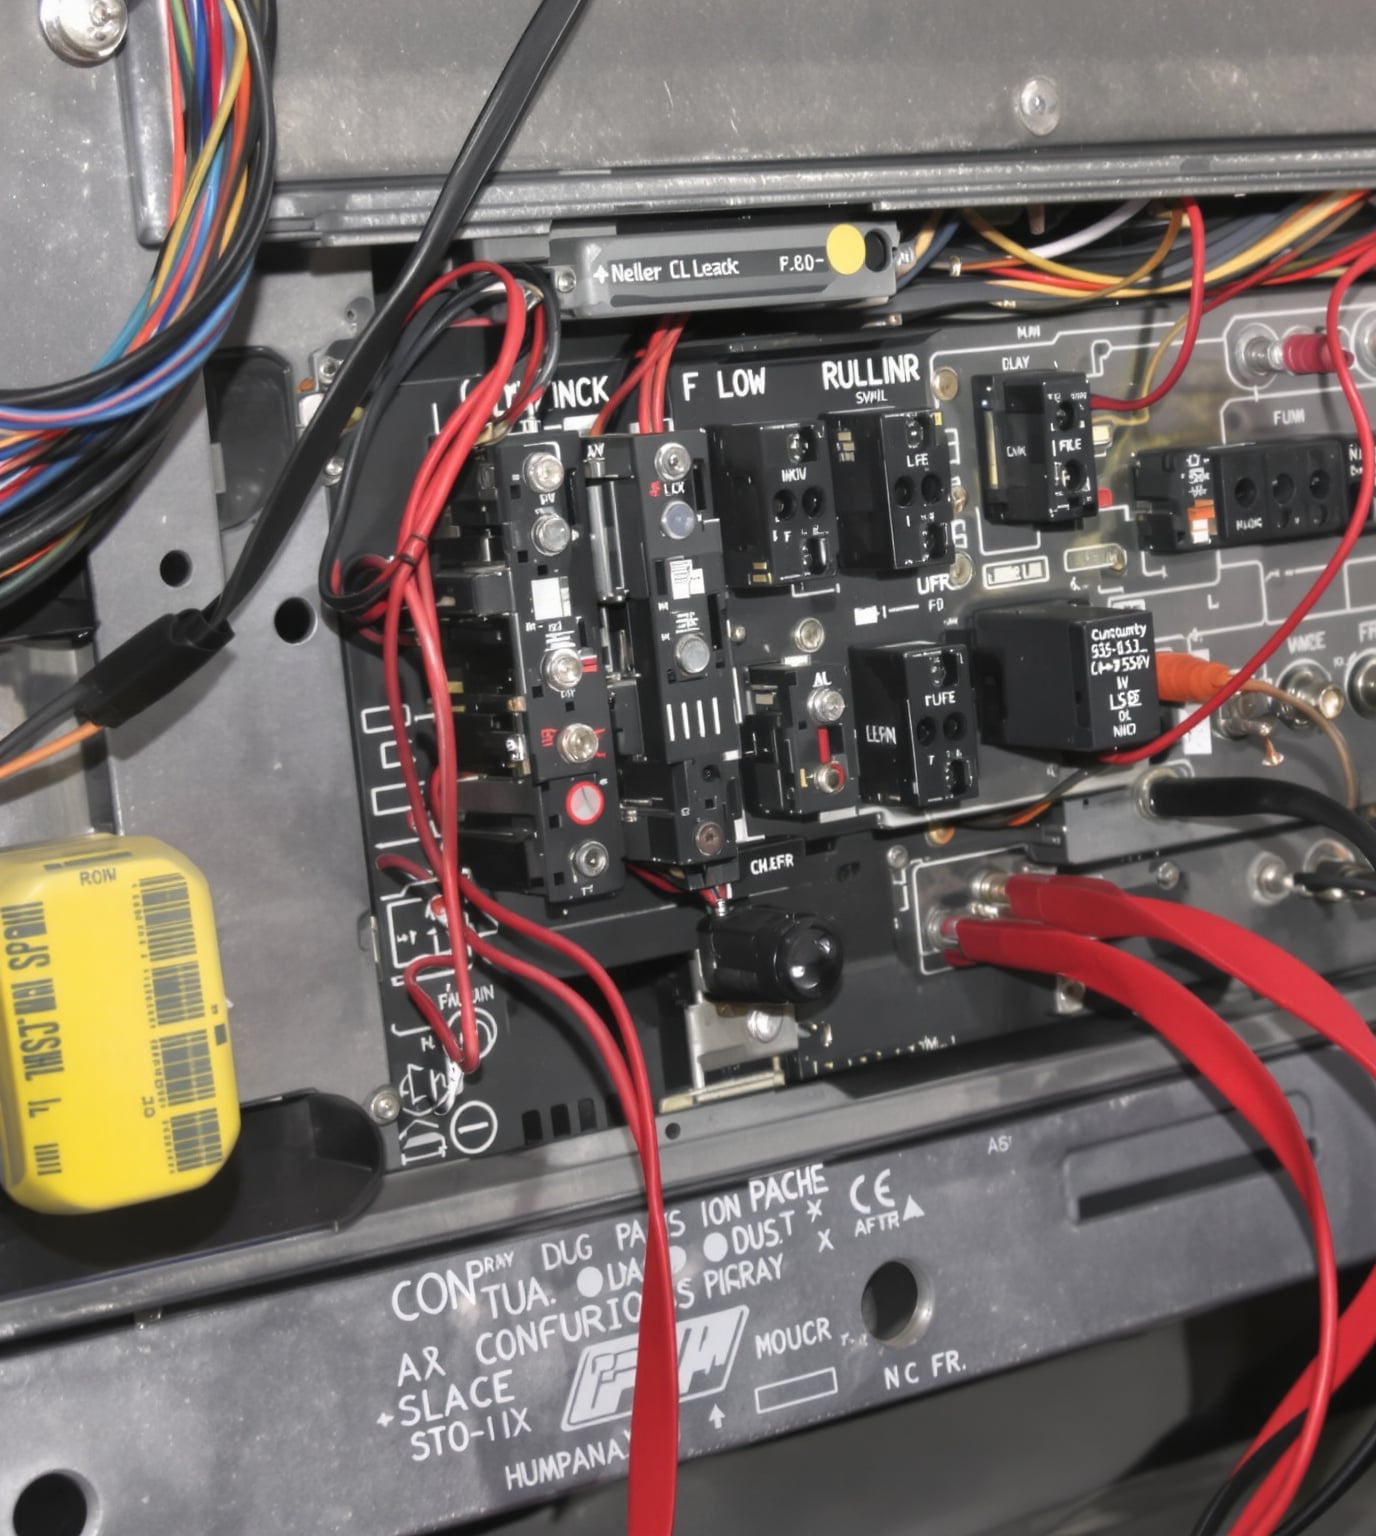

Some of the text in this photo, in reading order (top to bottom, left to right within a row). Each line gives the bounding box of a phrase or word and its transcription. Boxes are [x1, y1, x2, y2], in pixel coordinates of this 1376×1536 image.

[611, 262, 662, 283] Neller
[716, 366, 766, 399] LOW
[748, 1162, 829, 1213] PACHE
